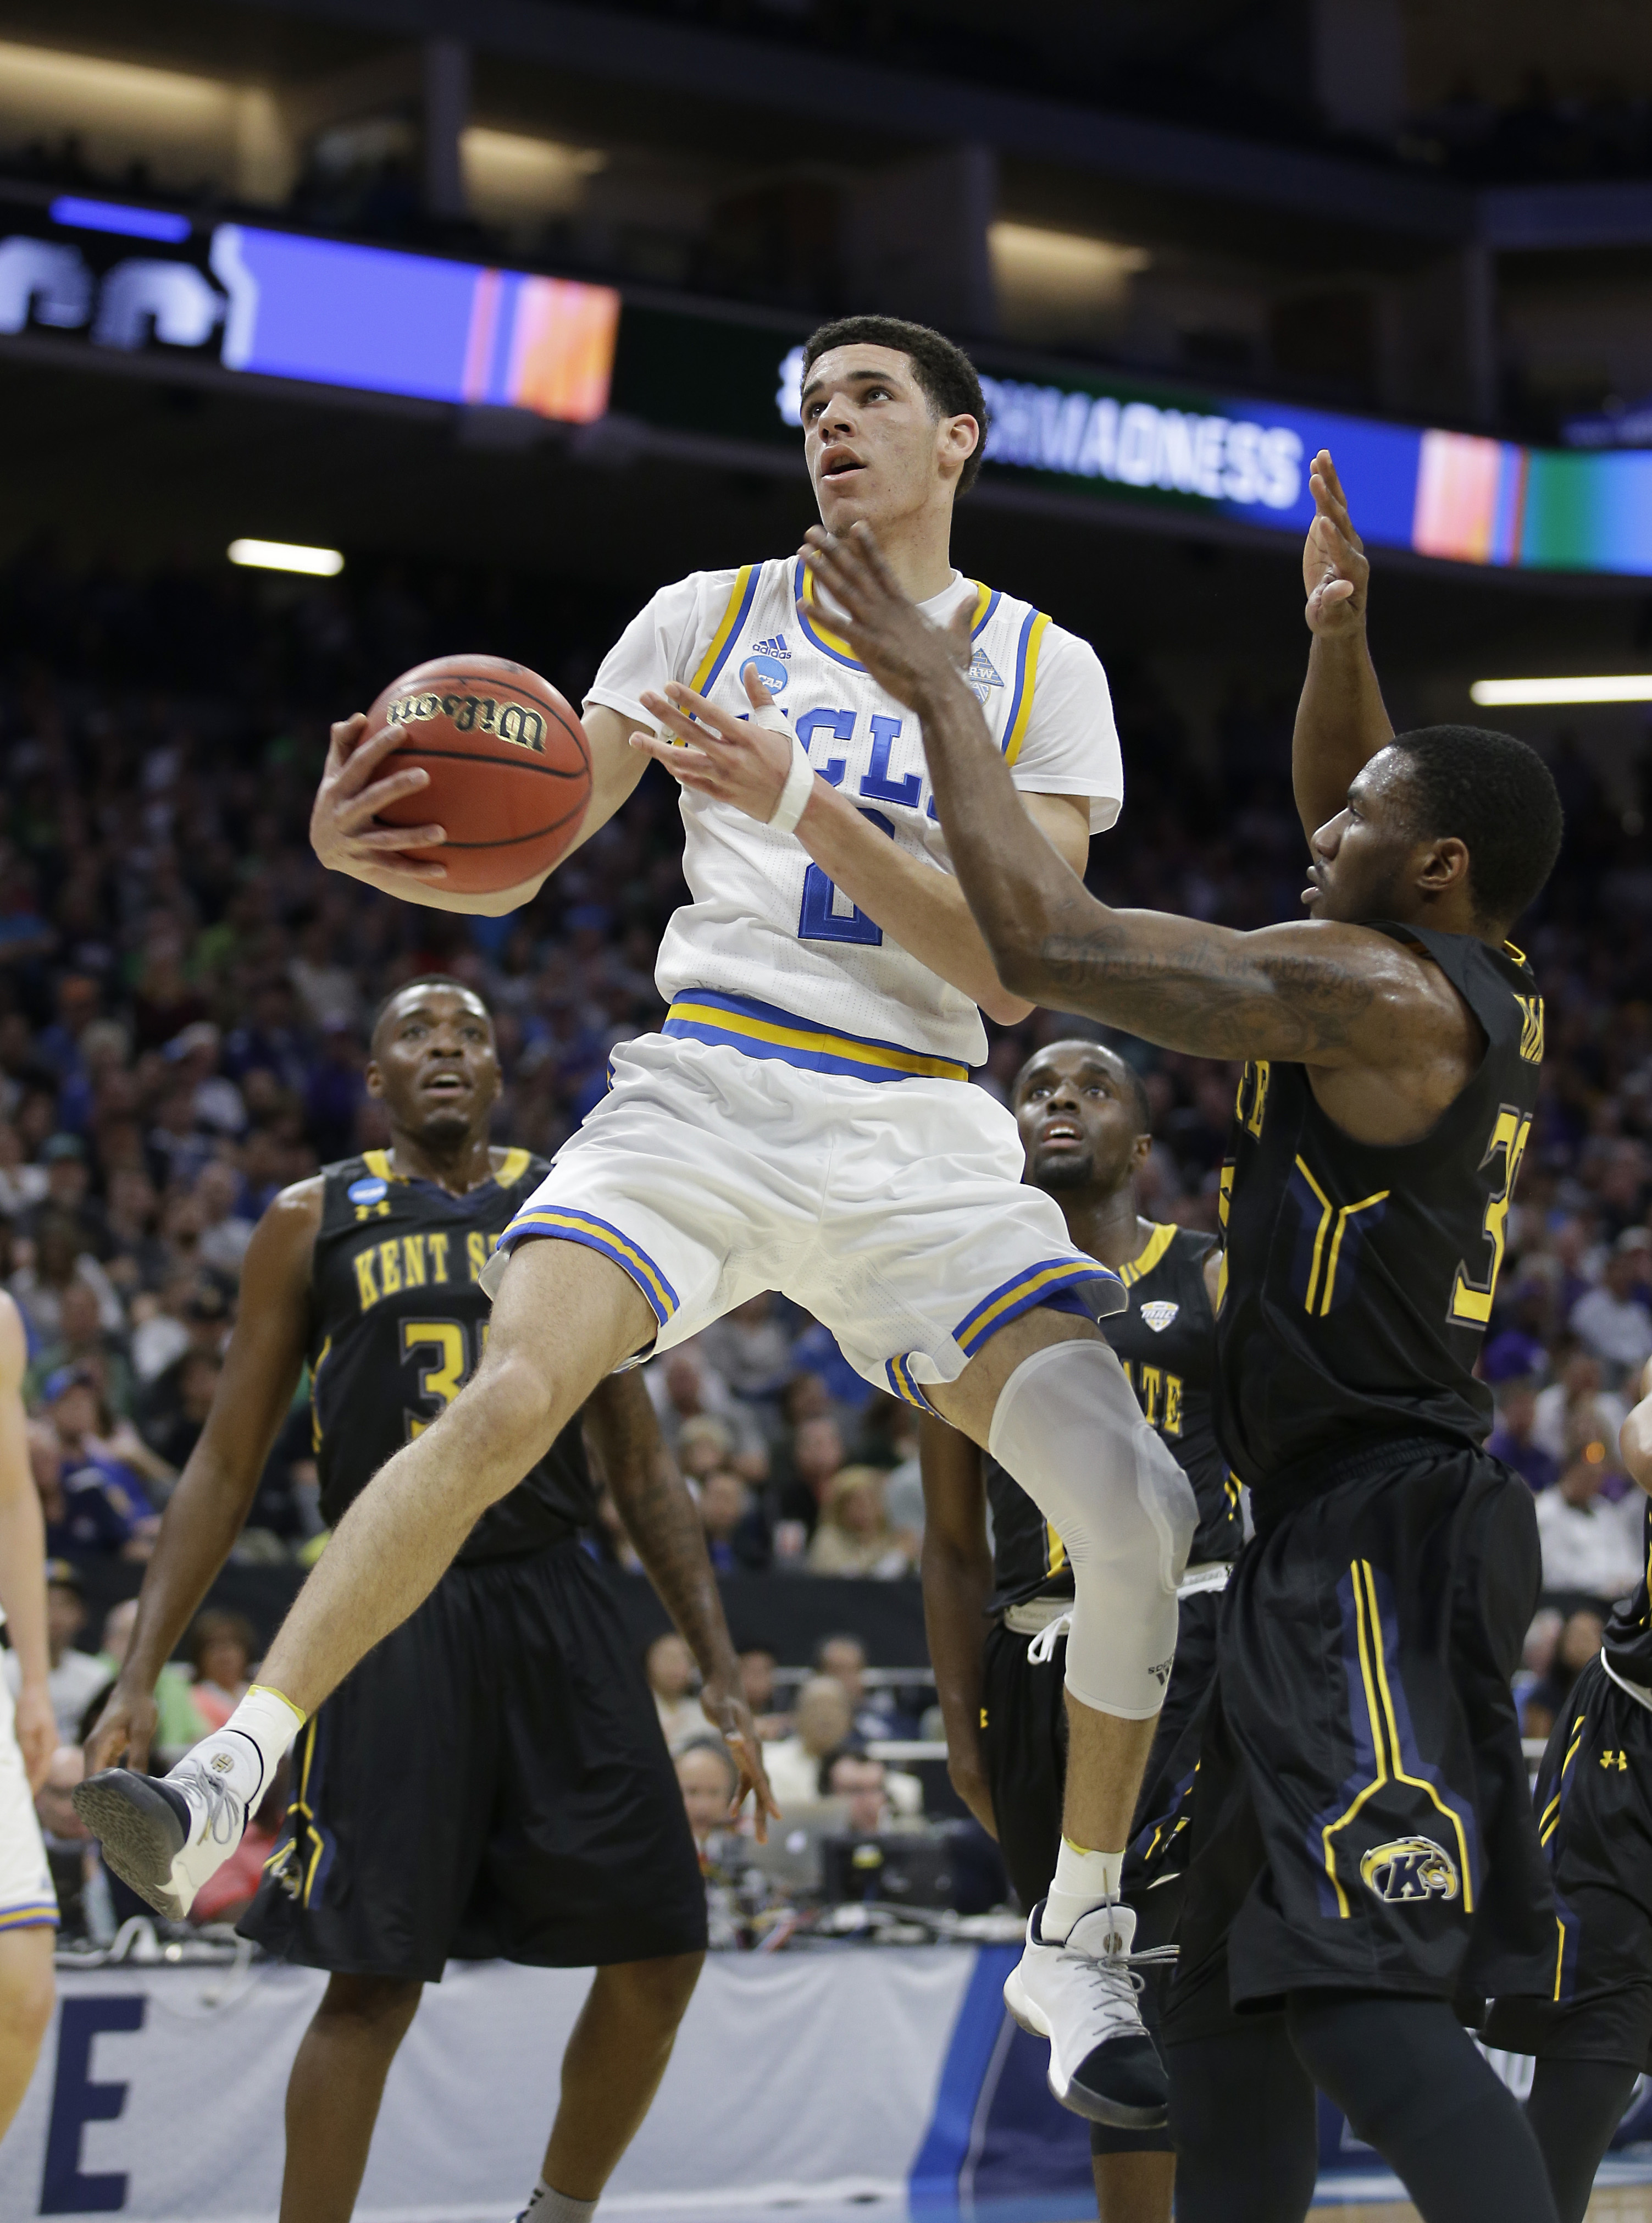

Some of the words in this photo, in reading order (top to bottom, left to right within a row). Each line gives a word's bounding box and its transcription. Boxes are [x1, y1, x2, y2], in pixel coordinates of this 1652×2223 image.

[752, 644, 792, 659] adidas
[758, 674, 783, 690] CAA
[386, 692, 547, 755] Wilson
[735, 707, 939, 821] CL
[353, 1232, 449, 1313] KENT
[399, 1318, 491, 1440] 3
[1122, 1359, 1184, 1437] TE
[1384, 1850, 1434, 1903] K
[38, 1993, 149, 2216] E
